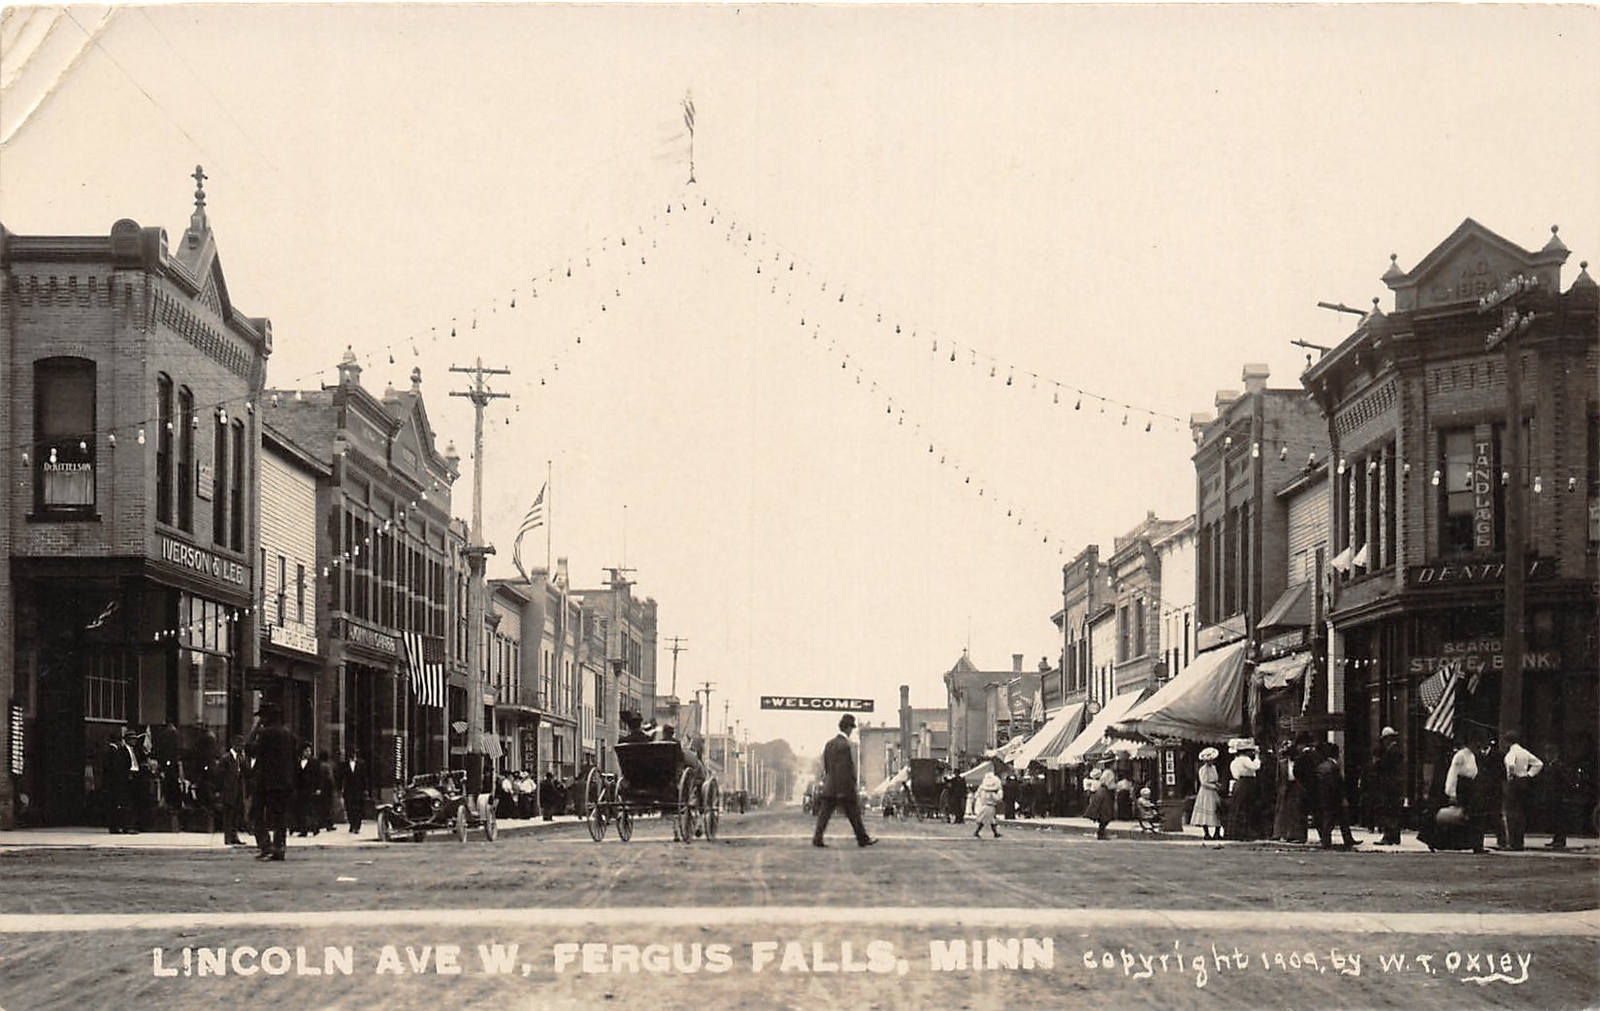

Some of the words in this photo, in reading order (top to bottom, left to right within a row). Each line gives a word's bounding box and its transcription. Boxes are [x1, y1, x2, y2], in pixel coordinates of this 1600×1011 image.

[162, 537, 210, 573] IVERSON
[212, 557, 220, 576] &
[1418, 560, 1540, 583] DENTIT
[772, 697, 862, 709] WELCOME
